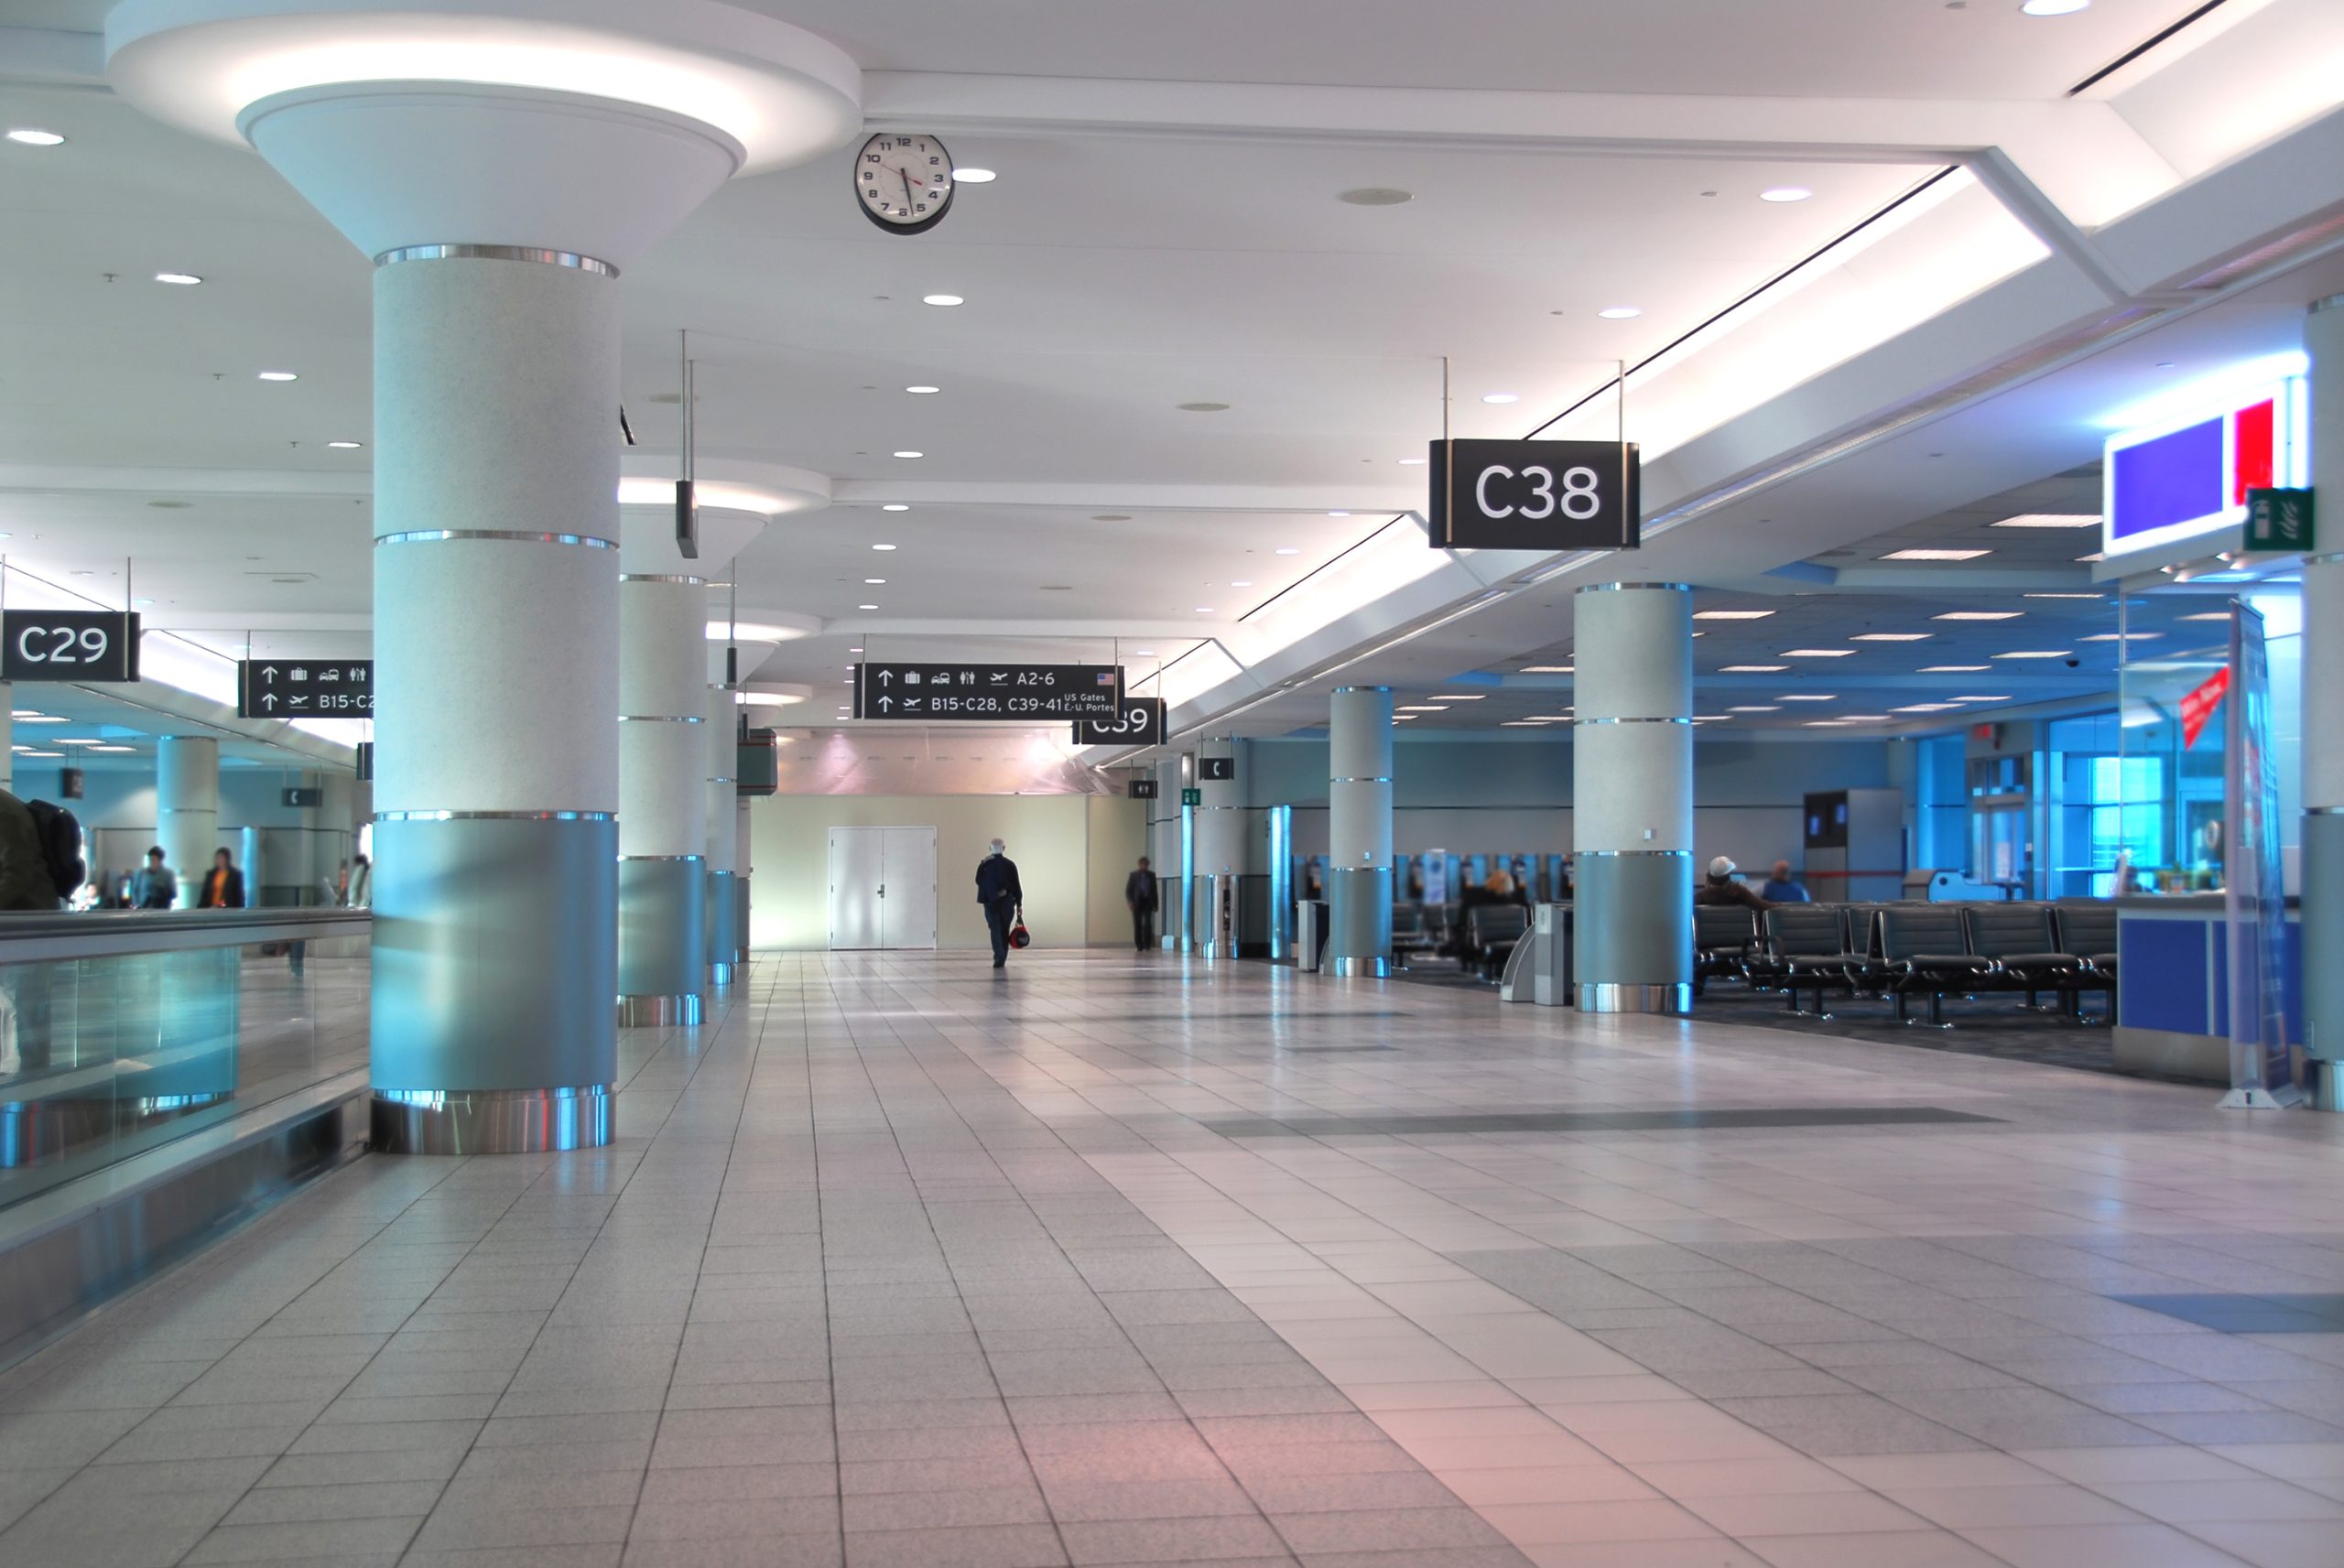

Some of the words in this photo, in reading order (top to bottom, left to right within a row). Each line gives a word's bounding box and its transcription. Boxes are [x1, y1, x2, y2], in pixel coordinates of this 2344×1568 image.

[896, 137, 912, 146] 12
[880, 142, 892, 151] 11
[866, 154, 881, 163] 10
[929, 157, 939, 165] 2
[863, 172, 874, 180] 9
[934, 174, 944, 183] 3
[868, 189, 878, 199] 8
[928, 191, 939, 200] 4
[881, 202, 890, 211] 7
[917, 203, 926, 212] 5
[898, 208, 907, 217] 6
[1475, 464, 1601, 520] C38
[18, 625, 108, 664] C29
[1016, 672, 1055, 686] A2-6
[1064, 693, 1077, 702] US
[1080, 693, 1106, 702] Gates
[931, 697, 1002, 713] B15-C28,
[1008, 697, 1062, 711] C39-41
[1086, 703, 1115, 712] Portes
